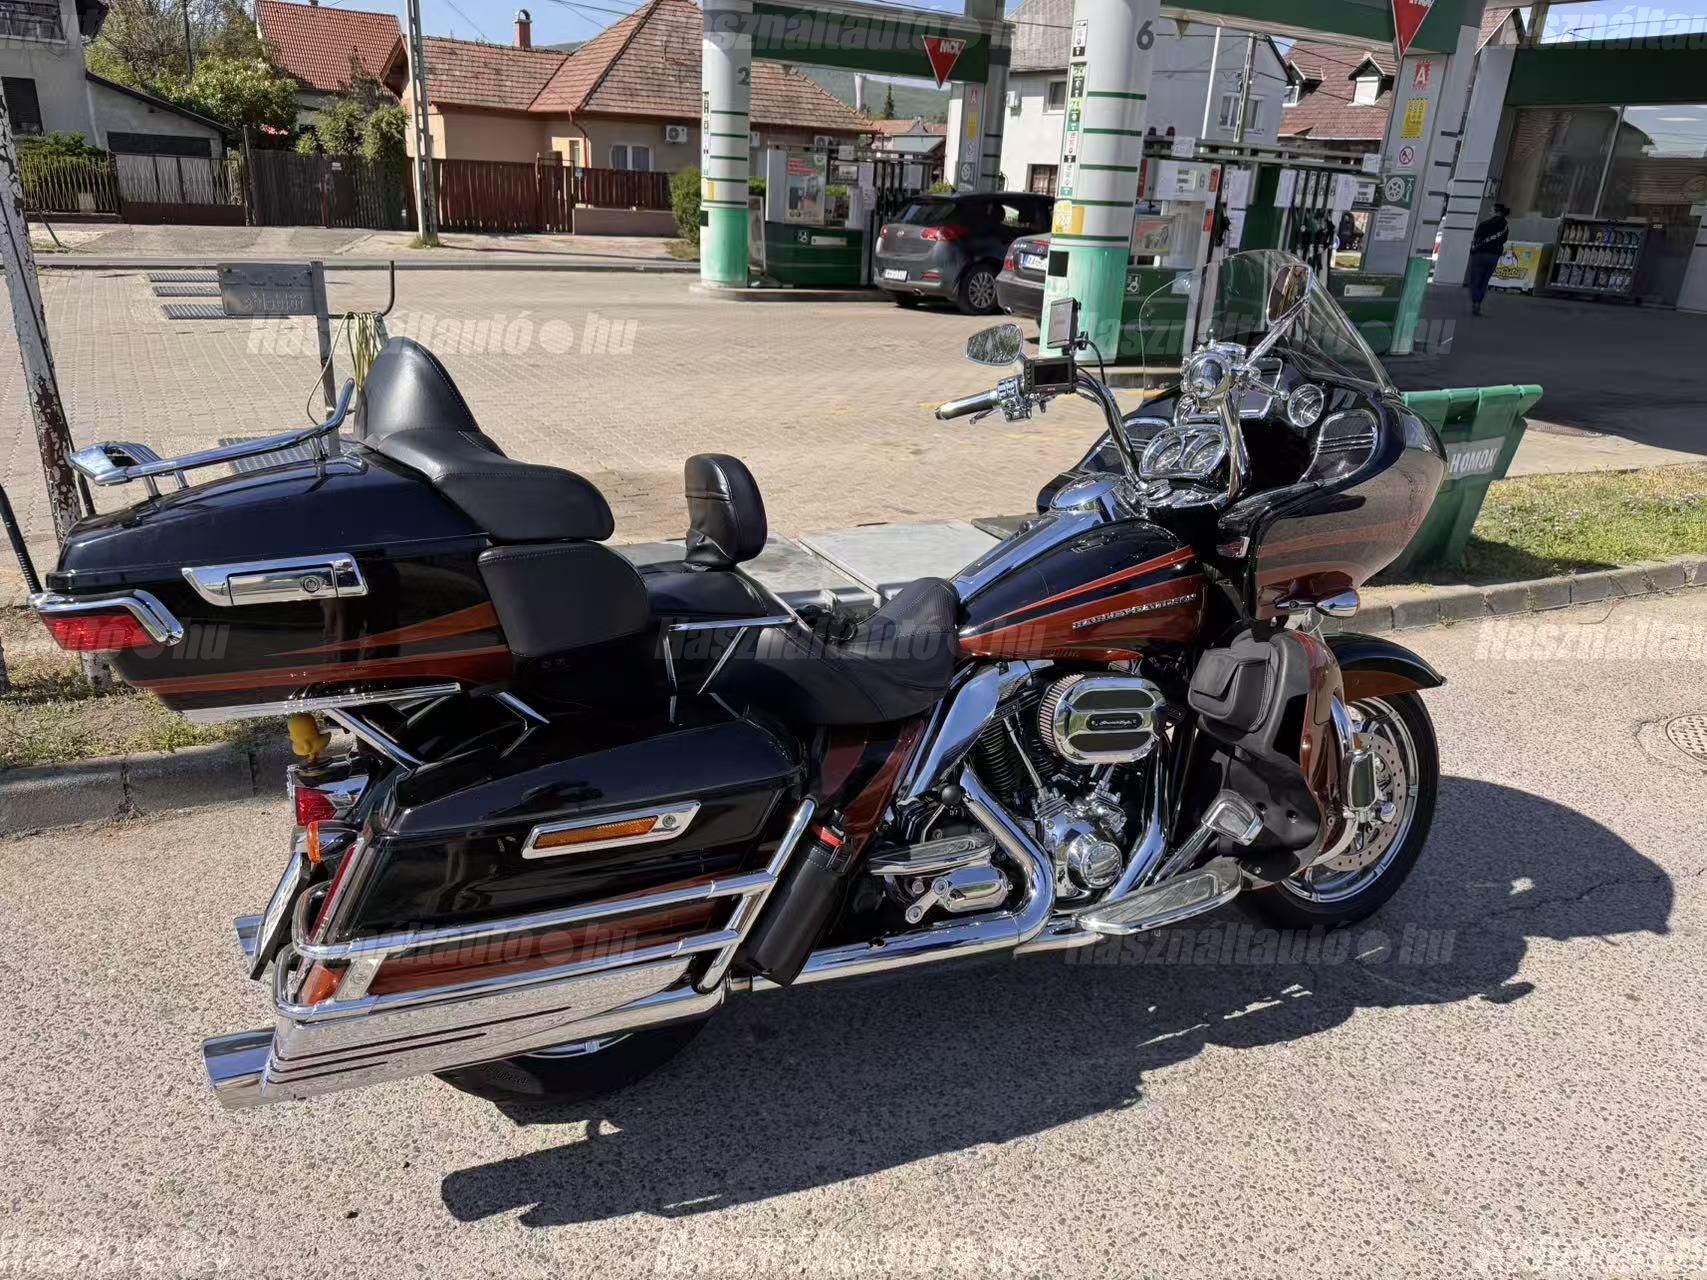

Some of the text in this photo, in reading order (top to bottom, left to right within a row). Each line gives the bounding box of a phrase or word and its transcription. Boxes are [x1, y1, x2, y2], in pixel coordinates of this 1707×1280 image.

[1136, 19, 1155, 51] 6
[940, 39, 961, 55] MOL
[737, 66, 751, 86] 2
[1414, 66, 1428, 85] A
[1449, 447, 1498, 473] HOMOK
